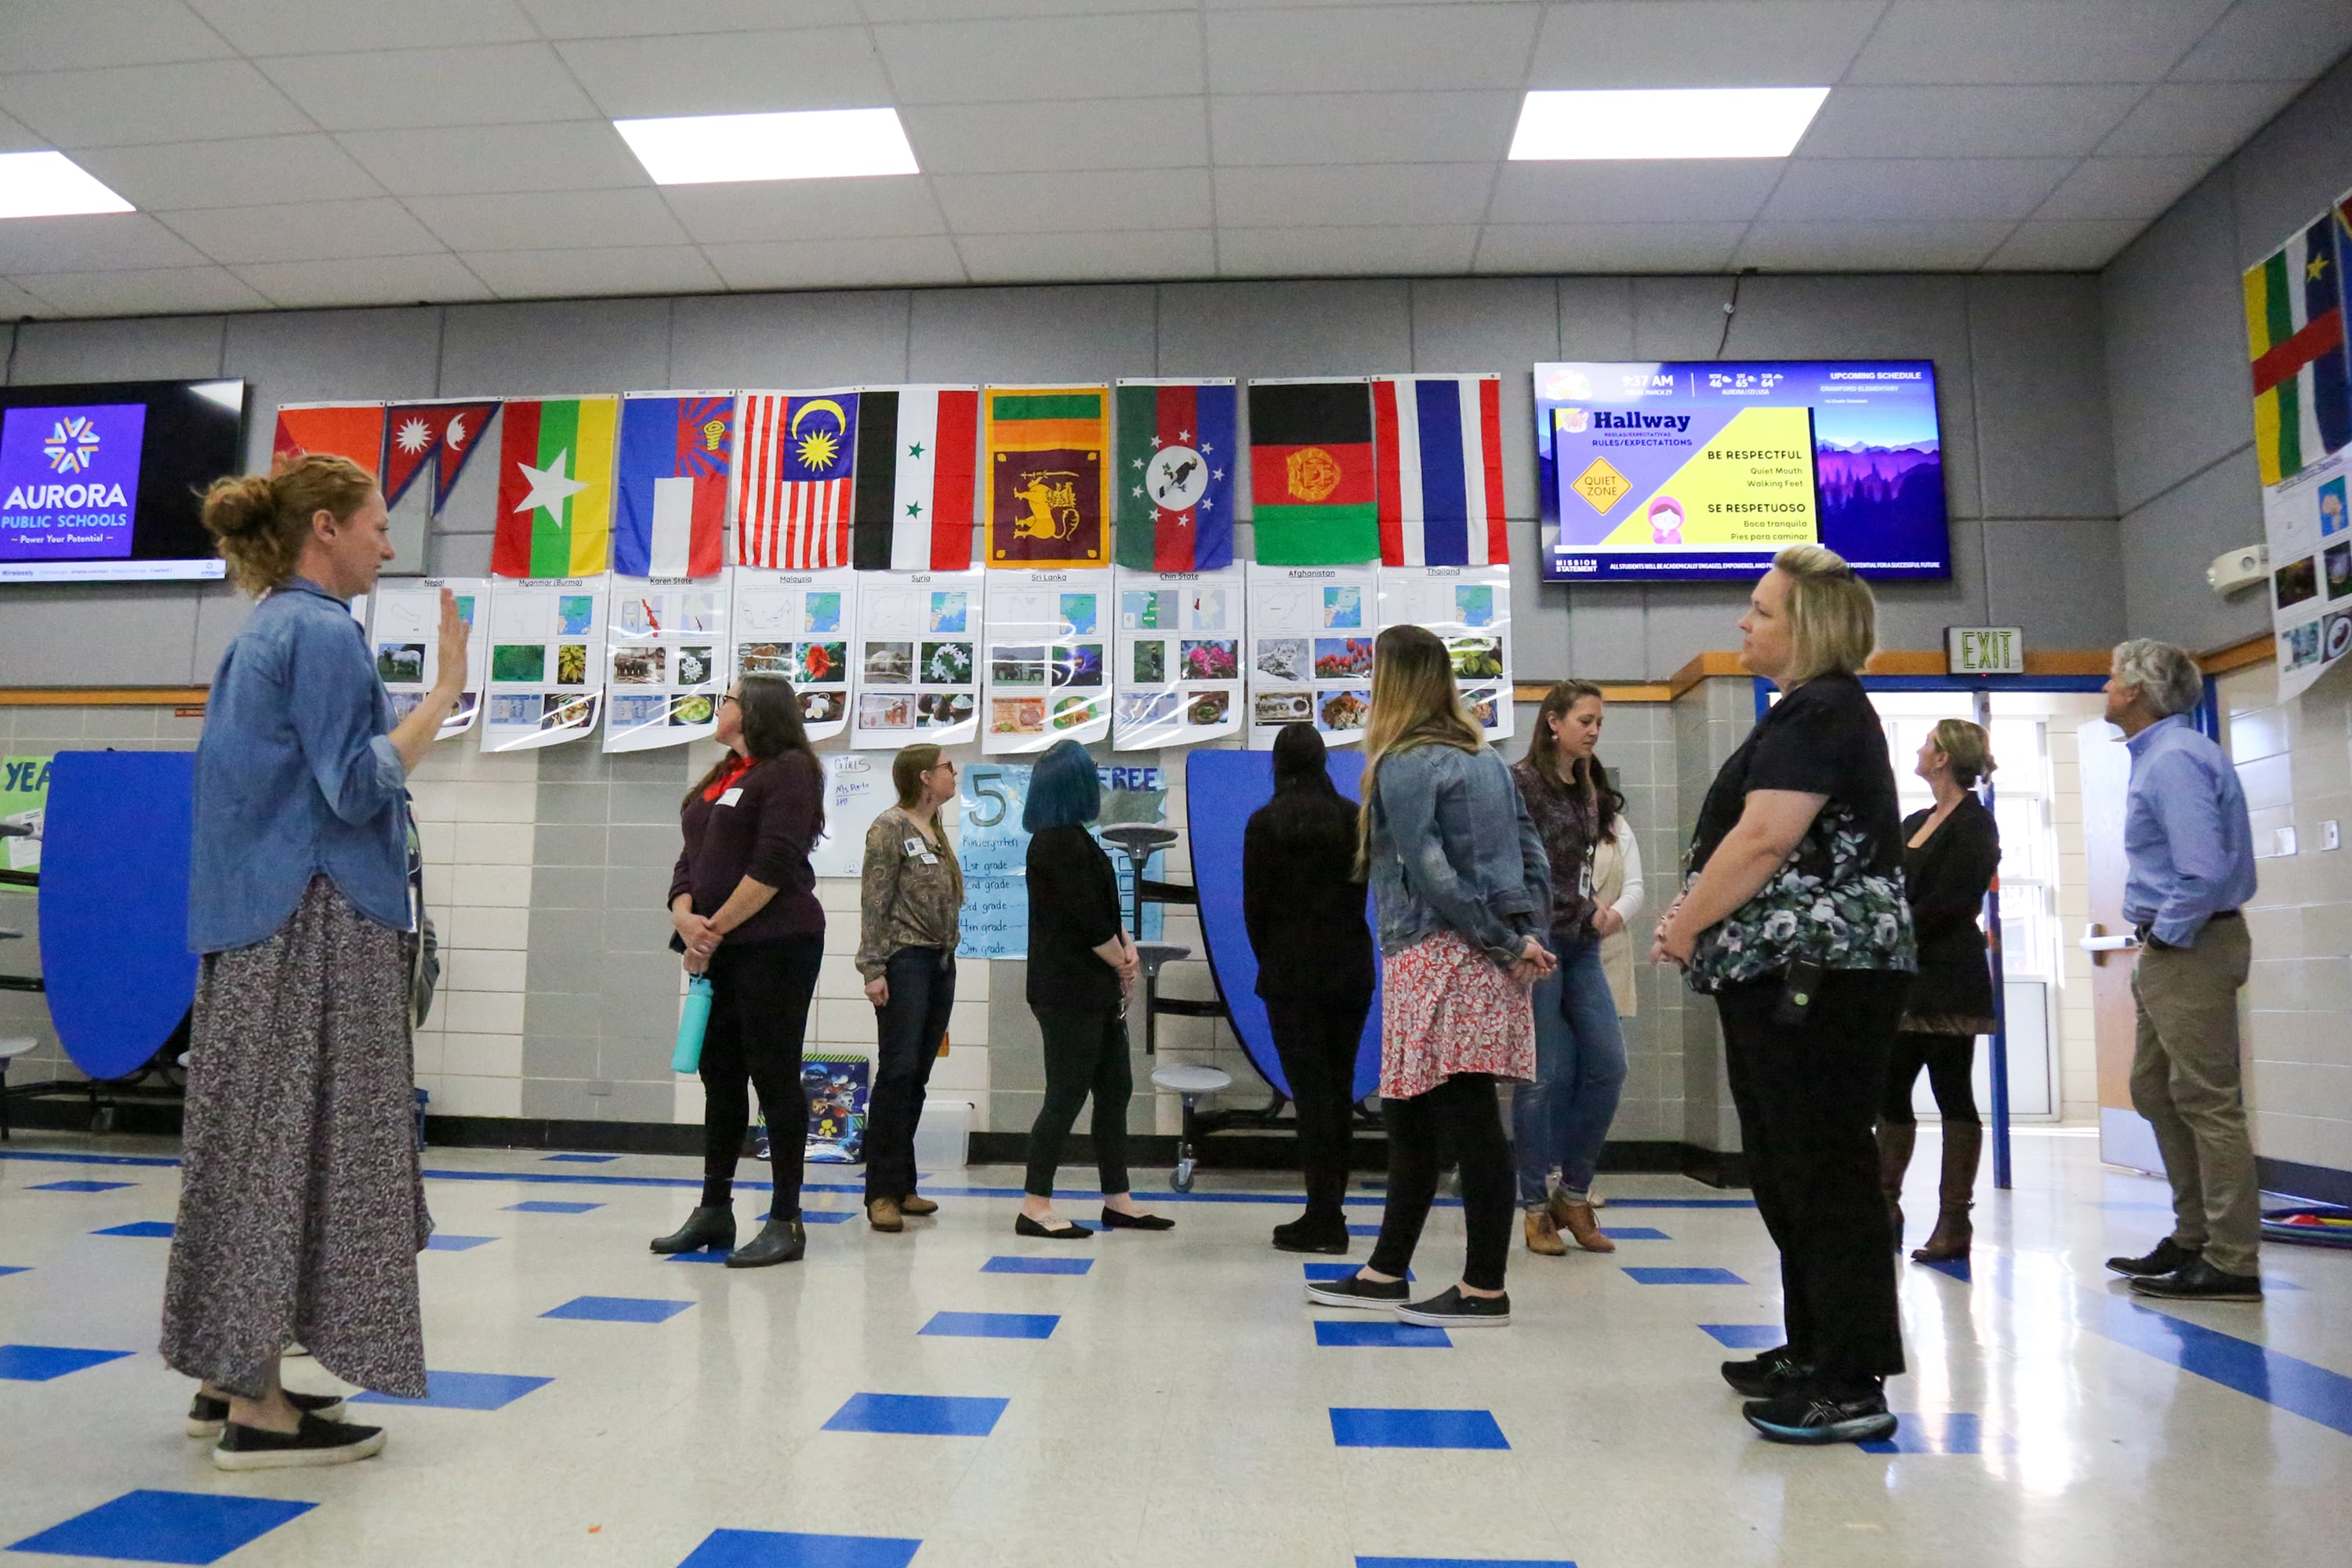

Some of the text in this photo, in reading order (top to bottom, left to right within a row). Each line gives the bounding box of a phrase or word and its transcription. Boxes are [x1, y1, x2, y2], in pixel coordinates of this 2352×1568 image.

[1622, 375, 1674, 387] 9:37 AM
[1761, 379, 1774, 387] 64
[1594, 412, 1691, 432] Hallway
[1708, 450, 1802, 459] BE RESPECTFUL
[1584, 476, 1617, 485] QUIET
[1747, 480, 1783, 488] Walking
[1588, 487, 1617, 495] ZONE
[3, 483, 128, 510] AURORA
[1708, 503, 1806, 513] SE RESPETUOSO
[1, 513, 127, 528] PUBLIC SCHOOLS
[20, 533, 103, 543] Power Your Potential
[1160, 572, 1200, 581] Chin State
[1288, 570, 1336, 579] Afghanistan
[1427, 568, 1461, 576] Thailand
[779, 575, 813, 584] Malaysia
[911, 575, 931, 583] Syria
[1031, 573, 1067, 582] Sri Lanka
[424, 579, 445, 587] Nepal
[518, 579, 583, 587] Myanmar (Burma)
[1962, 631, 2013, 669] EXIT
[969, 773, 1007, 827] 5
[963, 836, 1018, 852] Kindergarten
[963, 855, 1008, 876] 1st grade
[964, 877, 1010, 894] 2nd grade
[982, 901, 1007, 916] grade
[960, 918, 1007, 936] 4th grade
[959, 938, 1006, 958] 5th grade
